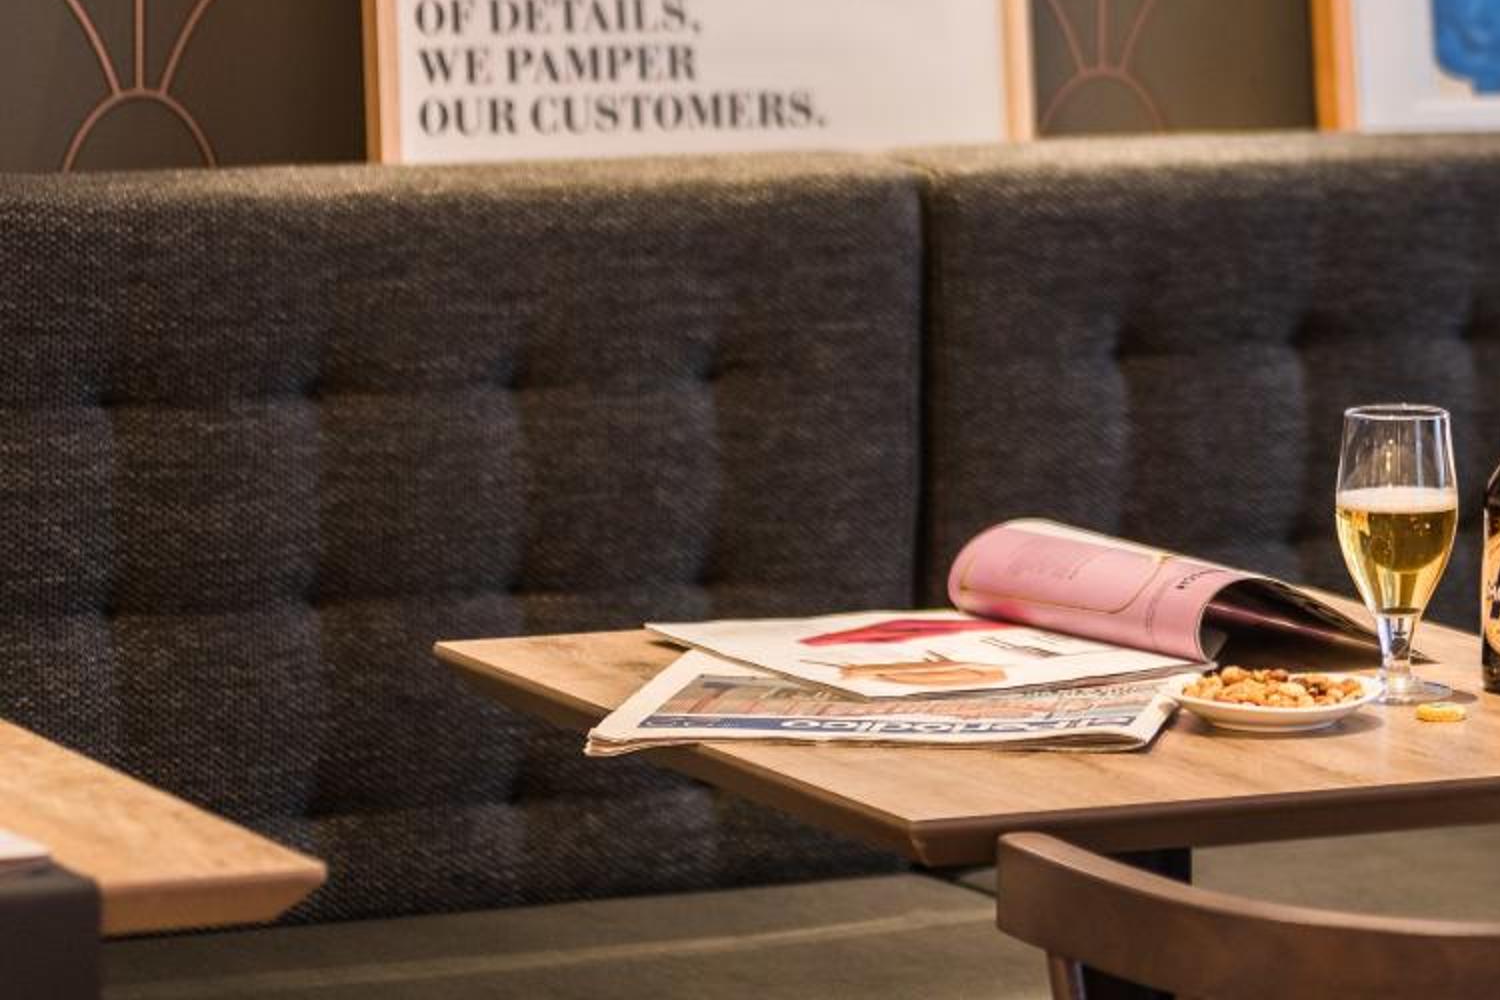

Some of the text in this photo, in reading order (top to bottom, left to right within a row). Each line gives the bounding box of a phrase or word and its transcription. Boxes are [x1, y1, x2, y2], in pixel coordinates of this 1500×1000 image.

[419, 43, 696, 86] WE PAMPER
[418, 90, 826, 136] OUR CUSTOMERS.
